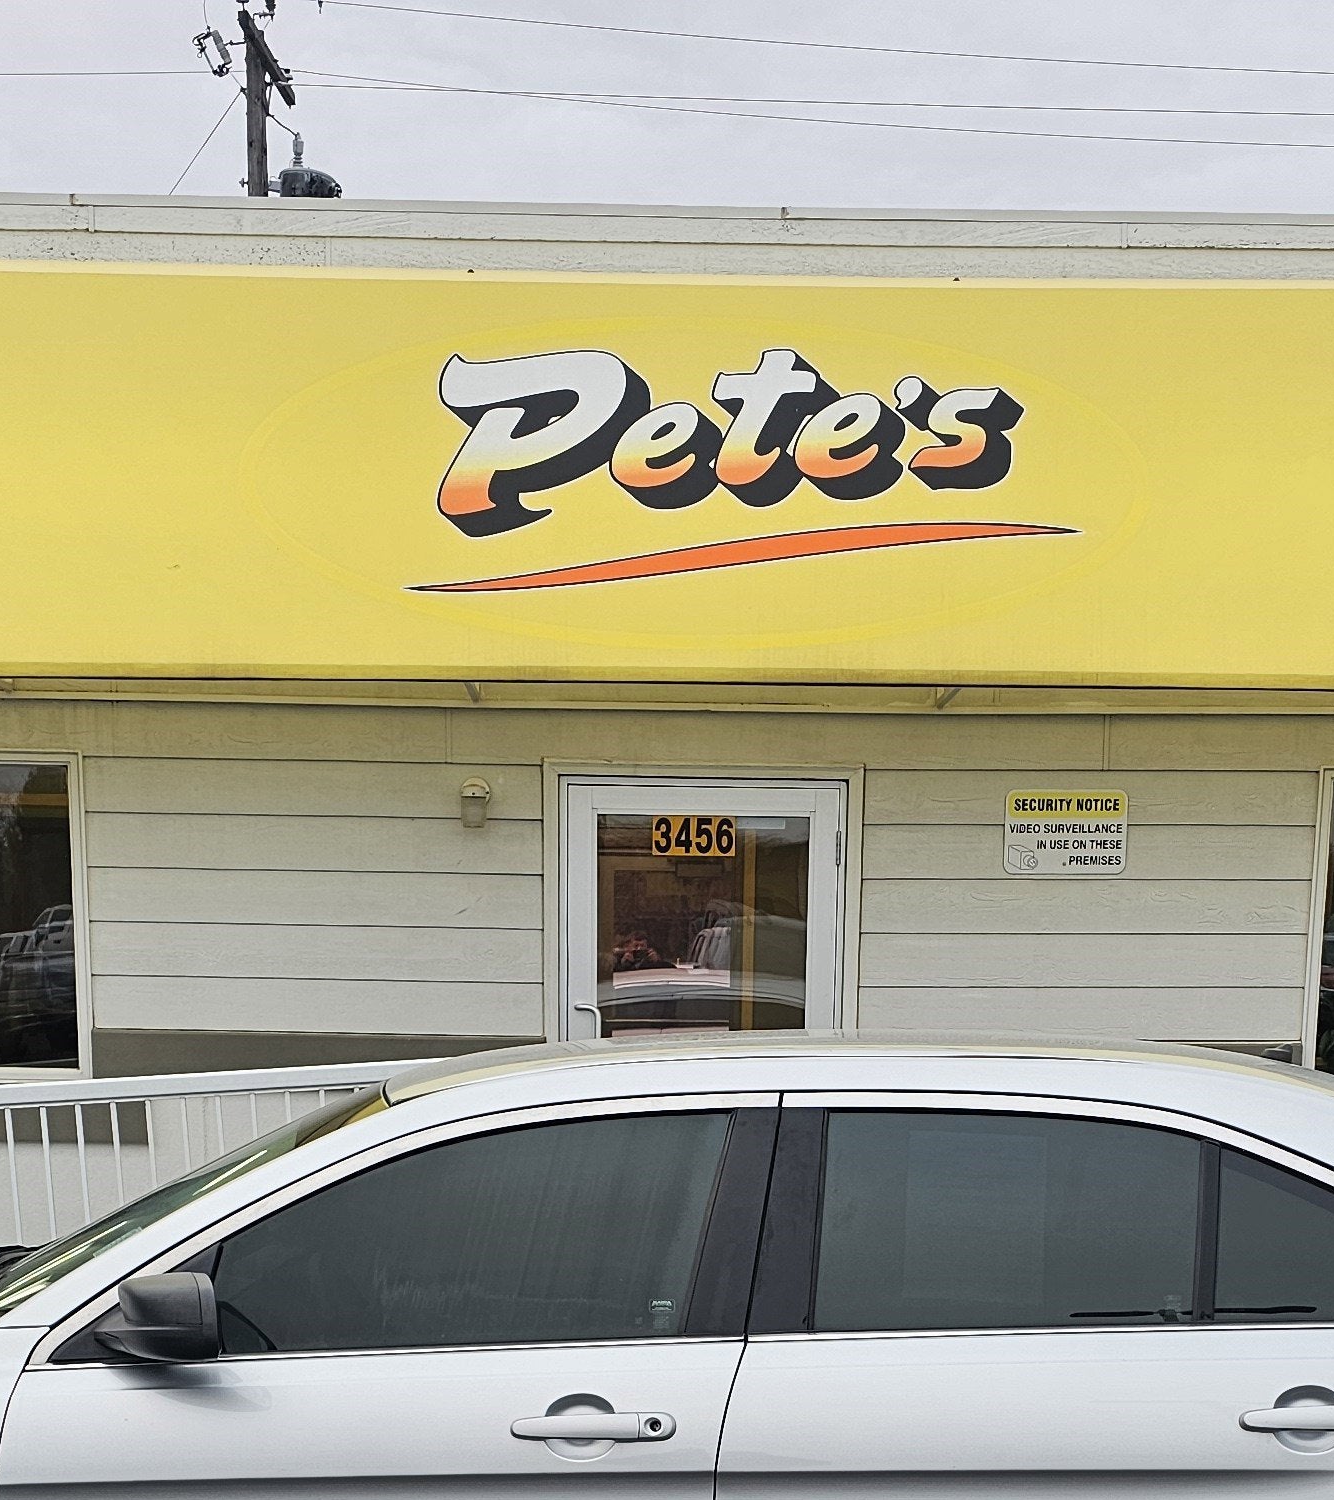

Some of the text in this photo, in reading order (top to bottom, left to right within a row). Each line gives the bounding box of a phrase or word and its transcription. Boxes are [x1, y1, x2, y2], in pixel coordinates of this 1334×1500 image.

[437, 348, 1019, 532] Pete's
[1013, 798, 1120, 812] SECURITY NOTICE
[1009, 823, 1123, 834] VIDEO SURVEILLANCE
[653, 816, 734, 854] 3456
[1036, 839, 1122, 850] IN USE ON THESE
[1068, 855, 1122, 866] PREMISES
